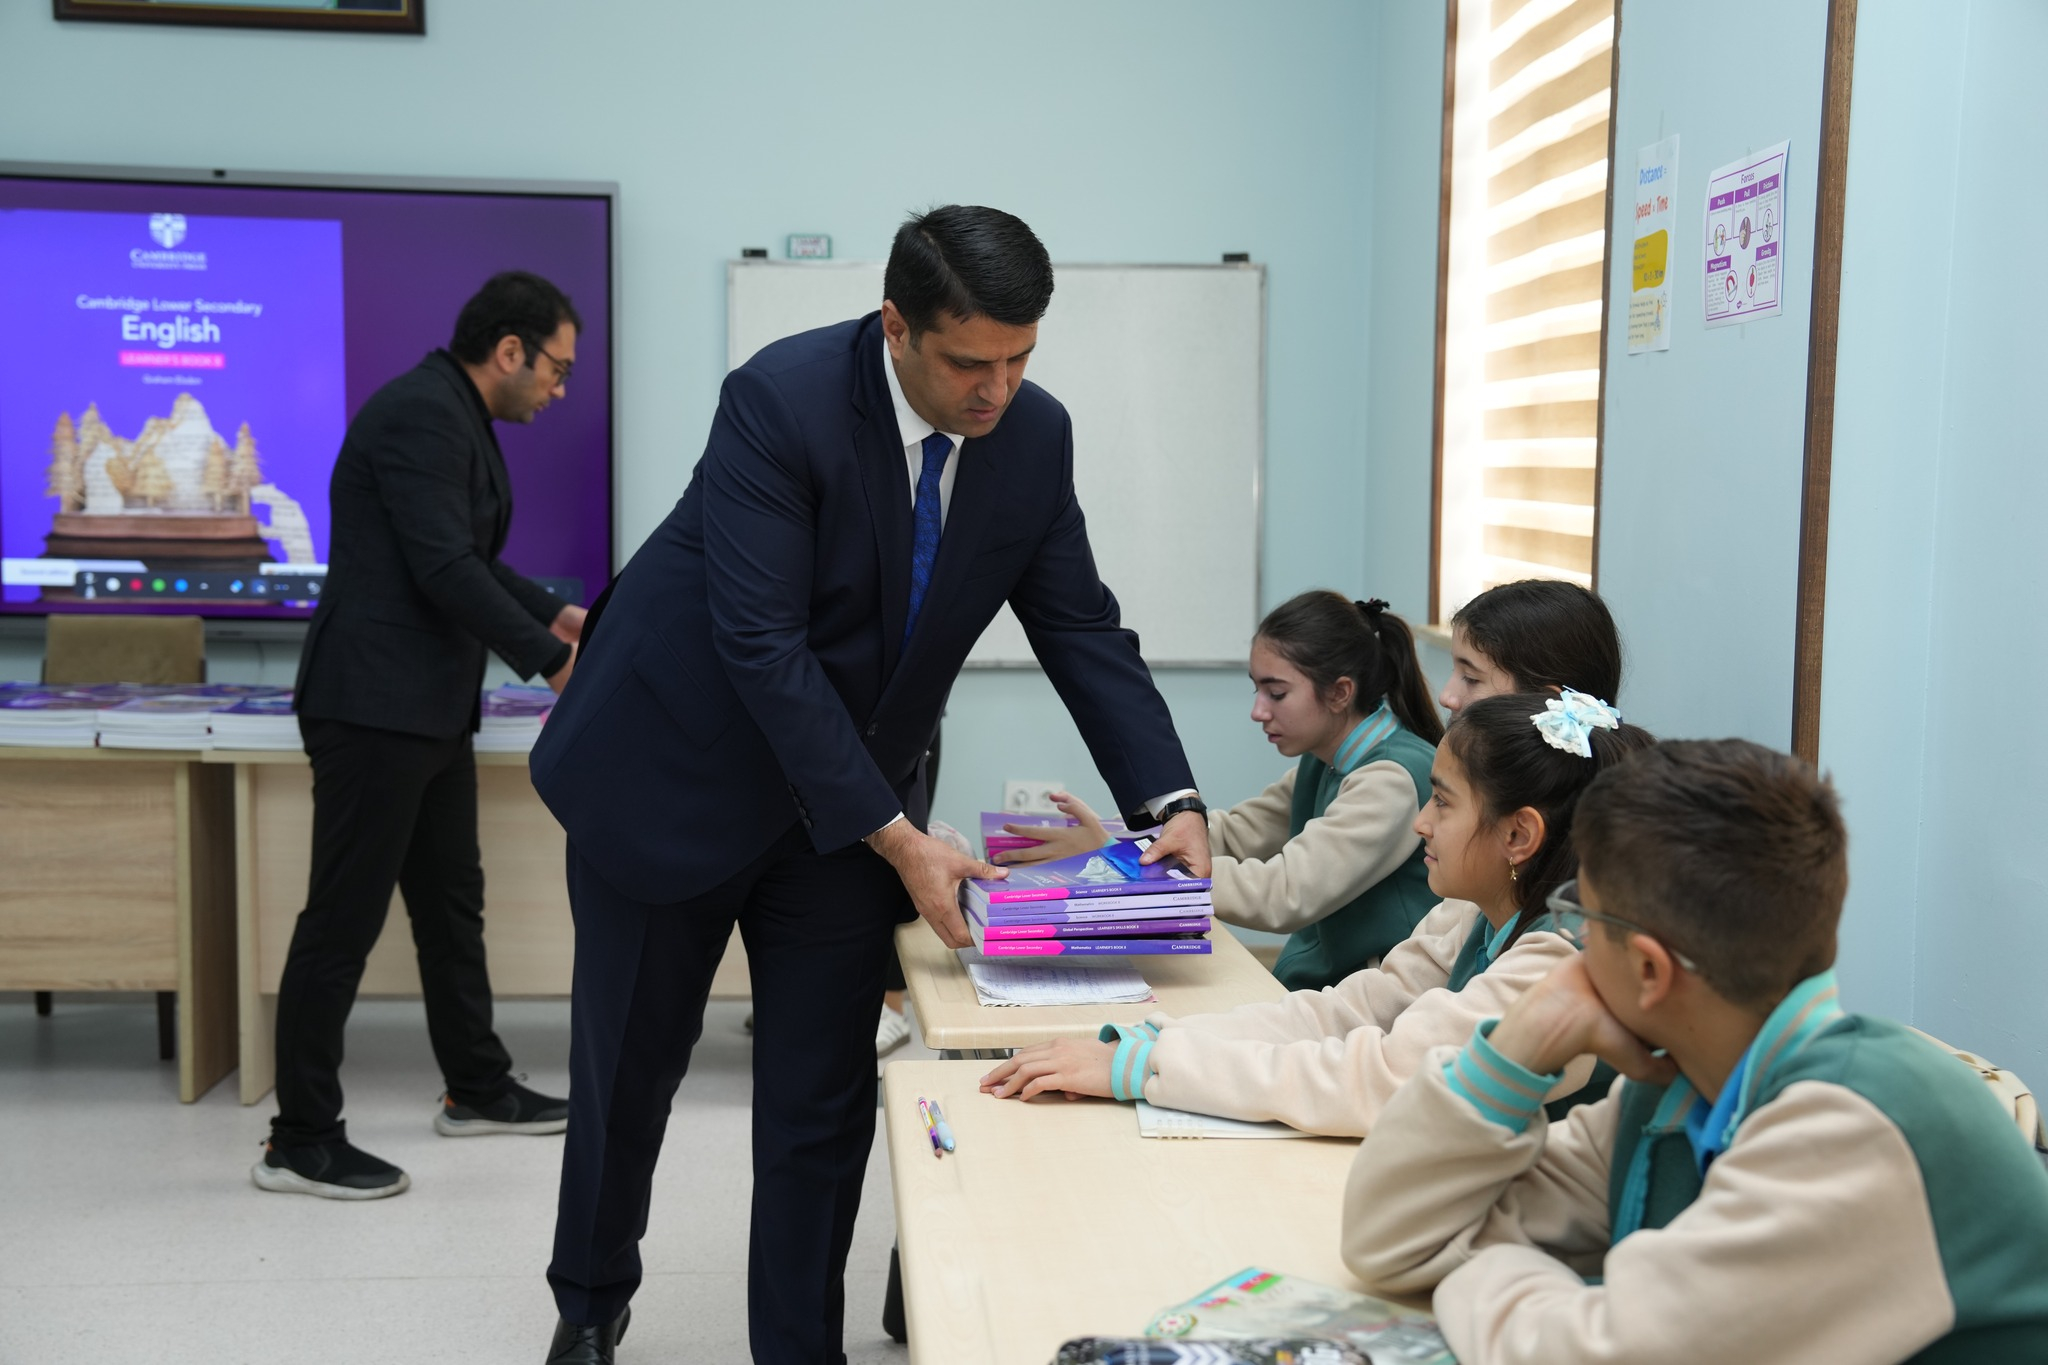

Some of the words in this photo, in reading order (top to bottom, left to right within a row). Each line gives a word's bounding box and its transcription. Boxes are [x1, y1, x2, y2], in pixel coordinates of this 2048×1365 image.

[76, 294, 150, 313] Cambridge
[152, 298, 192, 312] Lower
[194, 299, 263, 318] Secondary
[122, 314, 220, 349] English
